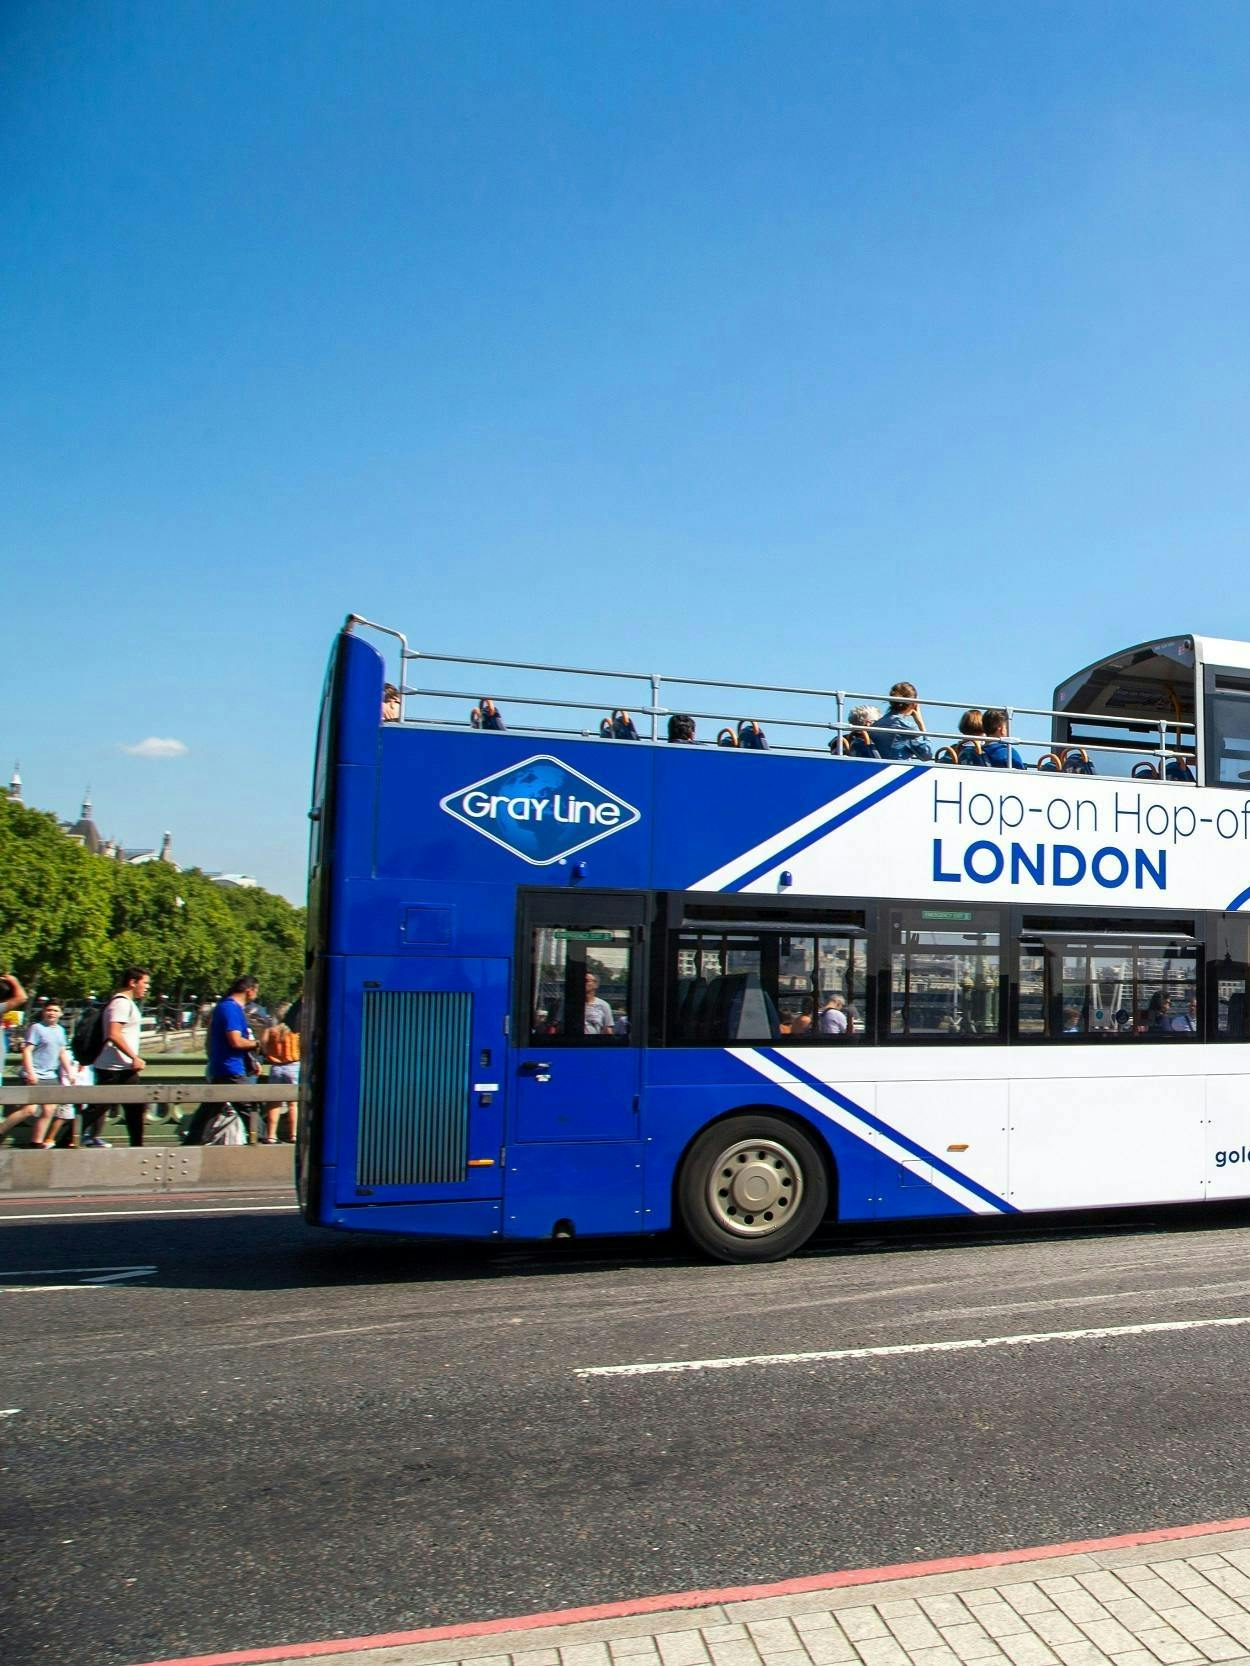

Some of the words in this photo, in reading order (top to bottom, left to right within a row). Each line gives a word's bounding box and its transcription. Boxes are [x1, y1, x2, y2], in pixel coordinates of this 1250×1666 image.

[462, 791, 550, 821] Gray
[553, 794, 621, 826] Line
[934, 779, 1098, 835] Hop-on
[933, 839, 1167, 890] LONDON
